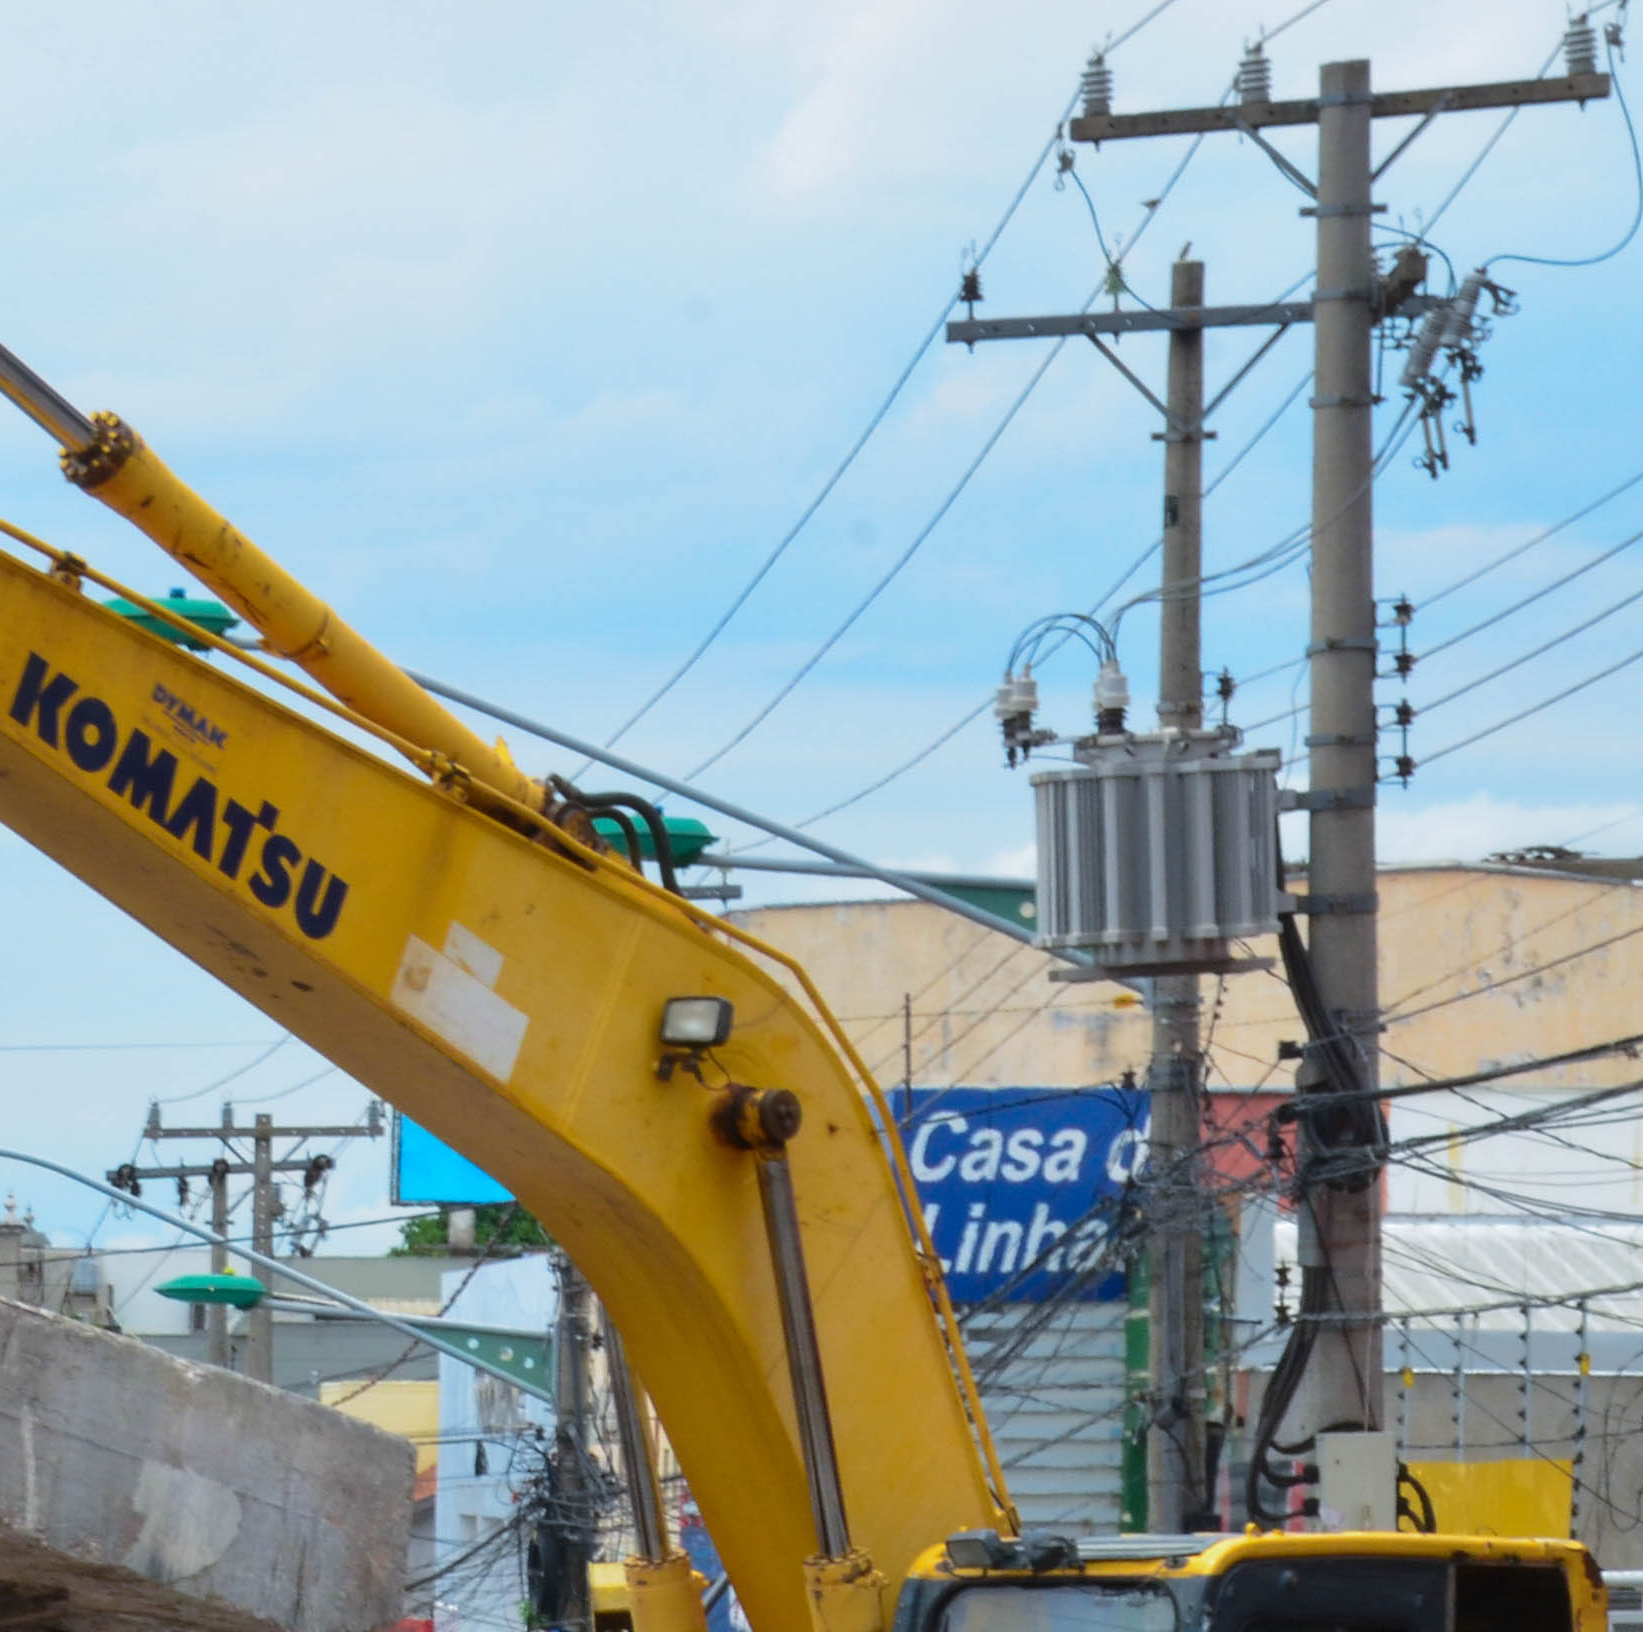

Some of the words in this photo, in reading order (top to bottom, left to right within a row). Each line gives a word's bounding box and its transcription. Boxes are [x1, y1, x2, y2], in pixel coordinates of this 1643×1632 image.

[9, 651, 350, 940] KOMATSU
[910, 1111, 1088, 1183] Casa
[1106, 1114, 1152, 1184] d
[914, 1203, 1136, 1274] Linha
